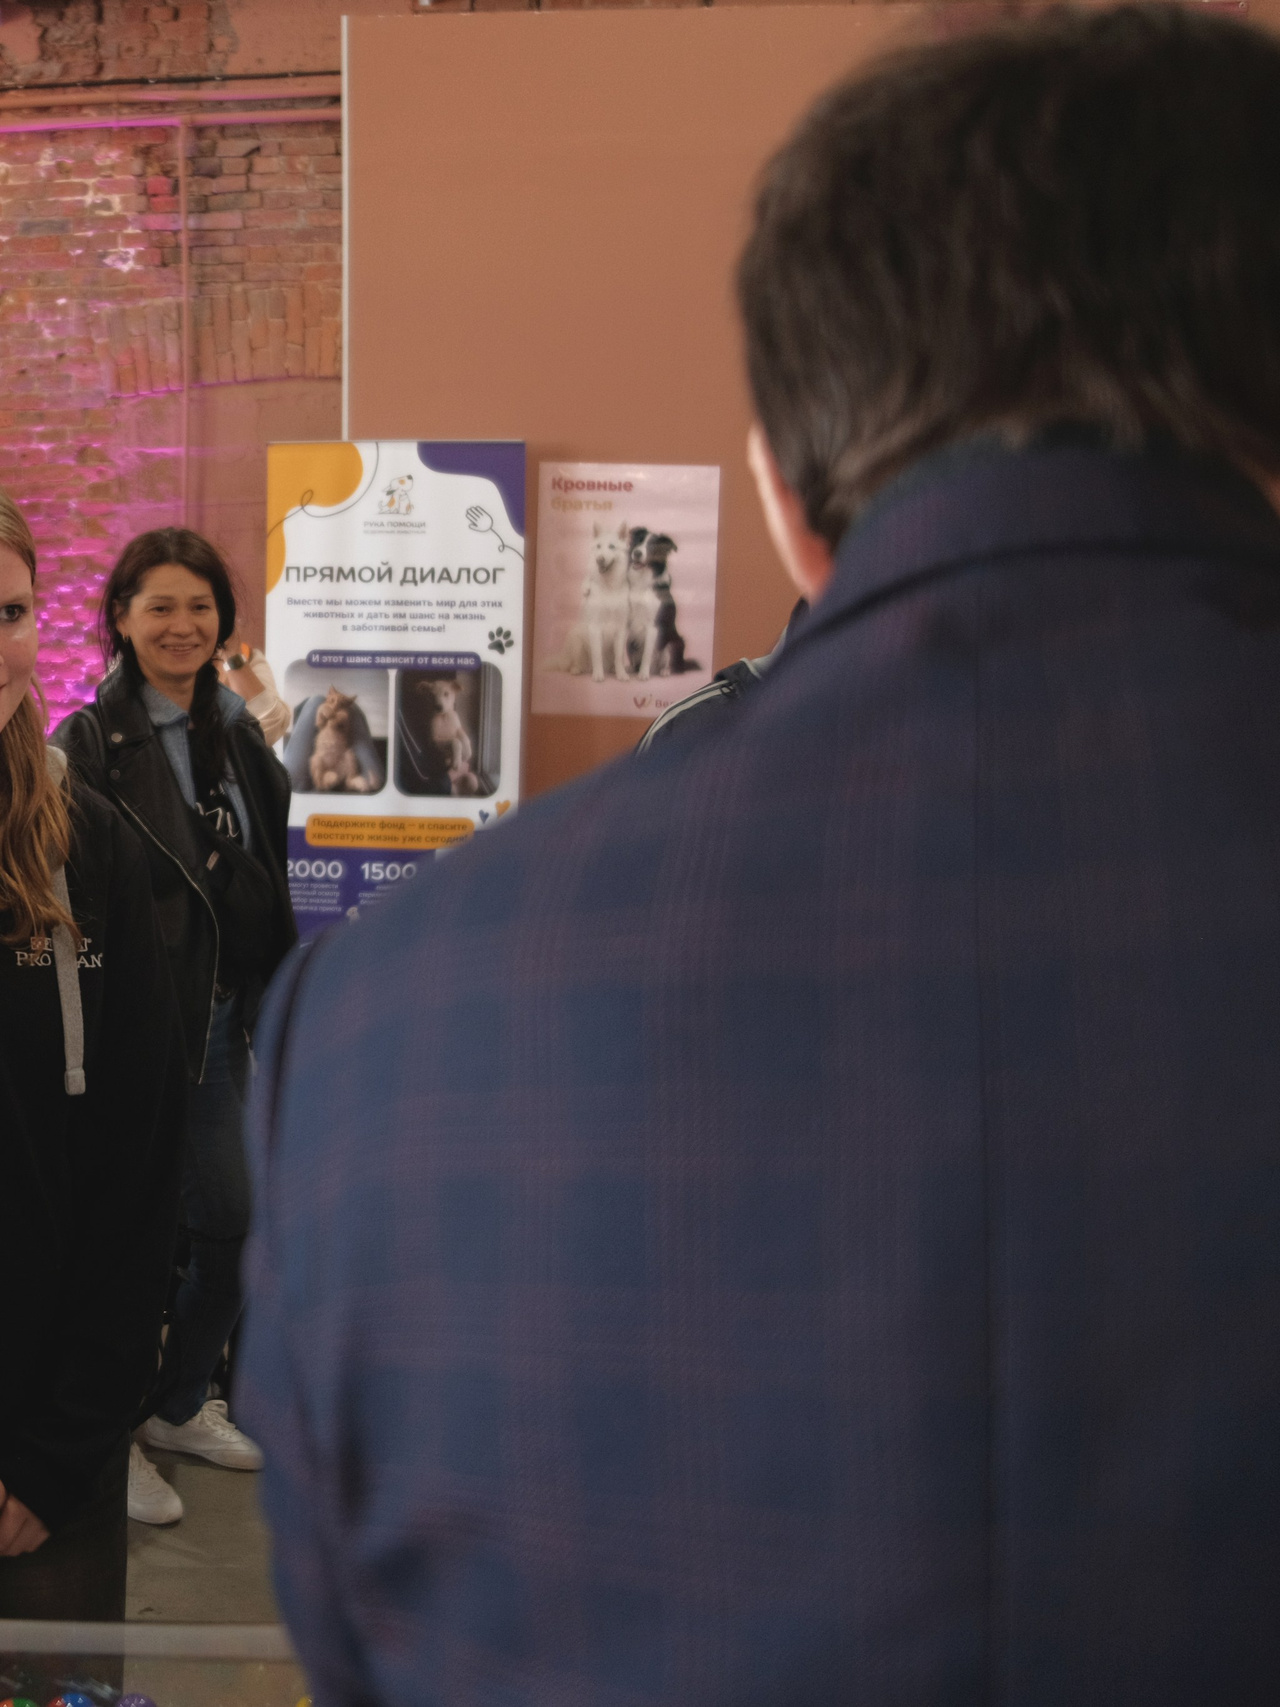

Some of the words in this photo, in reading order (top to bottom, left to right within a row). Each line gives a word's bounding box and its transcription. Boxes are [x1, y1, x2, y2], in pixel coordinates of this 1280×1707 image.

[552, 477, 633, 492] Кровные
[387, 521, 426, 529] ПОМОЩИ
[285, 562, 392, 583] ПРЯМОЙ
[400, 567, 505, 586] ДИАЛОГ
[287, 597, 323, 607] Вместе
[326, 599, 342, 607] мы
[345, 599, 381, 607] можем
[384, 599, 433, 607] изменить
[436, 600, 455, 609] мир
[459, 600, 477, 609] для
[481, 600, 502, 608] этих
[303, 611, 354, 619] животных
[366, 612, 389, 621] дать
[409, 612, 435, 620] шанс
[453, 613, 485, 621] жизнь
[351, 623, 408, 632] заботливой
[411, 625, 446, 633] семье!
[346, 656, 372, 664] шанс
[375, 656, 414, 664] зависит
[313, 819, 376, 830] Поддержите
[379, 819, 405, 830] фонд
[312, 832, 364, 841] хвостатую
[403, 835, 422, 843] уже
[361, 862, 417, 880] 1500
[15, 951, 52, 967] PRO
